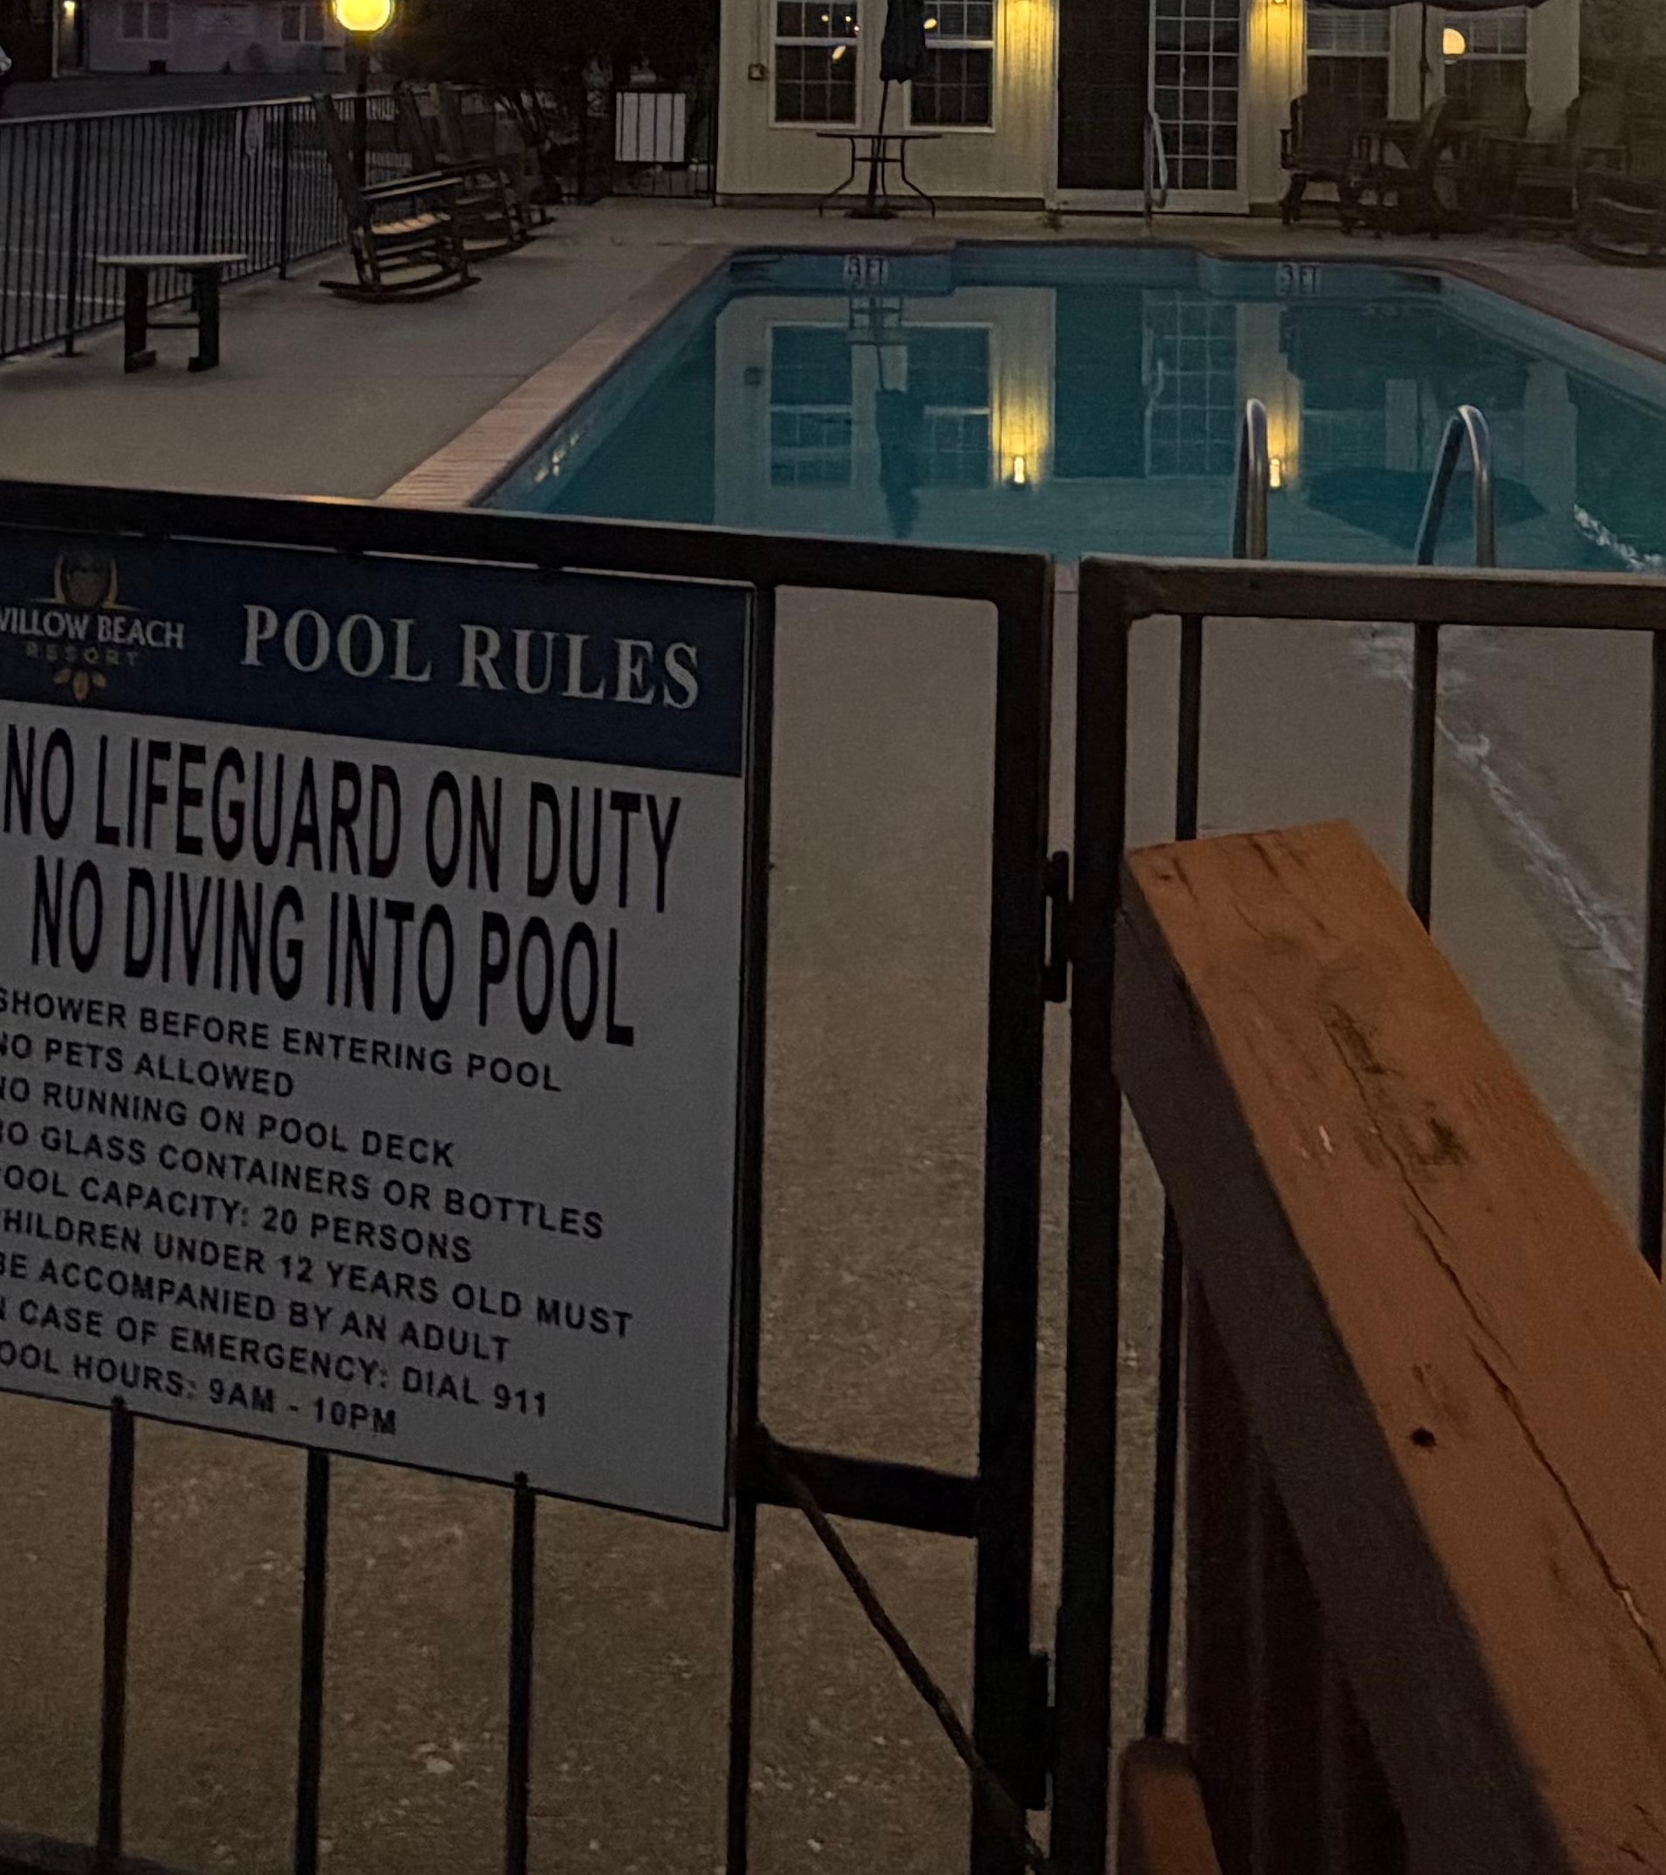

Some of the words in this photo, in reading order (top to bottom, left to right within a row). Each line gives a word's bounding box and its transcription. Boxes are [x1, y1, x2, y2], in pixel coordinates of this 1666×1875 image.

[25, 640, 140, 667] RESORT
[97, 614, 186, 650] BEACH
[240, 603, 432, 684] POOL
[456, 621, 702, 710] RULES
[2, 723, 75, 842] NO
[94, 733, 403, 880] LIFEGUARD
[424, 769, 503, 894] ON
[526, 780, 682, 914] DUTY
[30, 854, 105, 975] NO
[123, 866, 305, 1003] DIVING
[325, 890, 456, 1023] INTO
[478, 909, 635, 1048] POOL
[44, 1036, 124, 1074] PETS
[132, 1051, 295, 1099] ALLOWED
[139, 1006, 270, 1051] BEFORE
[282, 1026, 453, 1076] ENTERING
[466, 1052, 562, 1093] POOL
[42, 1081, 188, 1128] RUNNING
[199, 1104, 245, 1138] ON
[257, 1113, 349, 1154] POOL
[361, 1129, 455, 1169] DECK
[40, 1125, 147, 1167] GLASS
[157, 1143, 371, 1202] CONTAINERS
[383, 1178, 431, 1212] OR
[443, 1187, 604, 1240] BOTTLES
[79, 1175, 249, 1228] CAPACITY:
[261, 1204, 298, 1236] 20
[309, 1211, 473, 1264] PERSONS
[37, 1257, 277, 1323] ACCOMPANIED
[288, 1299, 335, 1333] BY
[339, 1309, 387, 1344] AN
[397, 1319, 511, 1364] ADULT
[153, 1231, 266, 1276] UNDER
[278, 1254, 314, 1285] 12
[326, 1260, 439, 1306] YEARS
[451, 1282, 523, 1319] OLD
[536, 1296, 633, 1339] MUST
[18, 1298, 104, 1339] CASE
[115, 1315, 159, 1347] OF
[169, 1324, 388, 1390] EMERGENCY:
[401, 1365, 481, 1406] DIAL
[493, 1383, 546, 1418] 911
[72, 1352, 197, 1400] HOURS:
[208, 1377, 277, 1415] 9AM
[312, 1396, 397, 1436] 10PM
